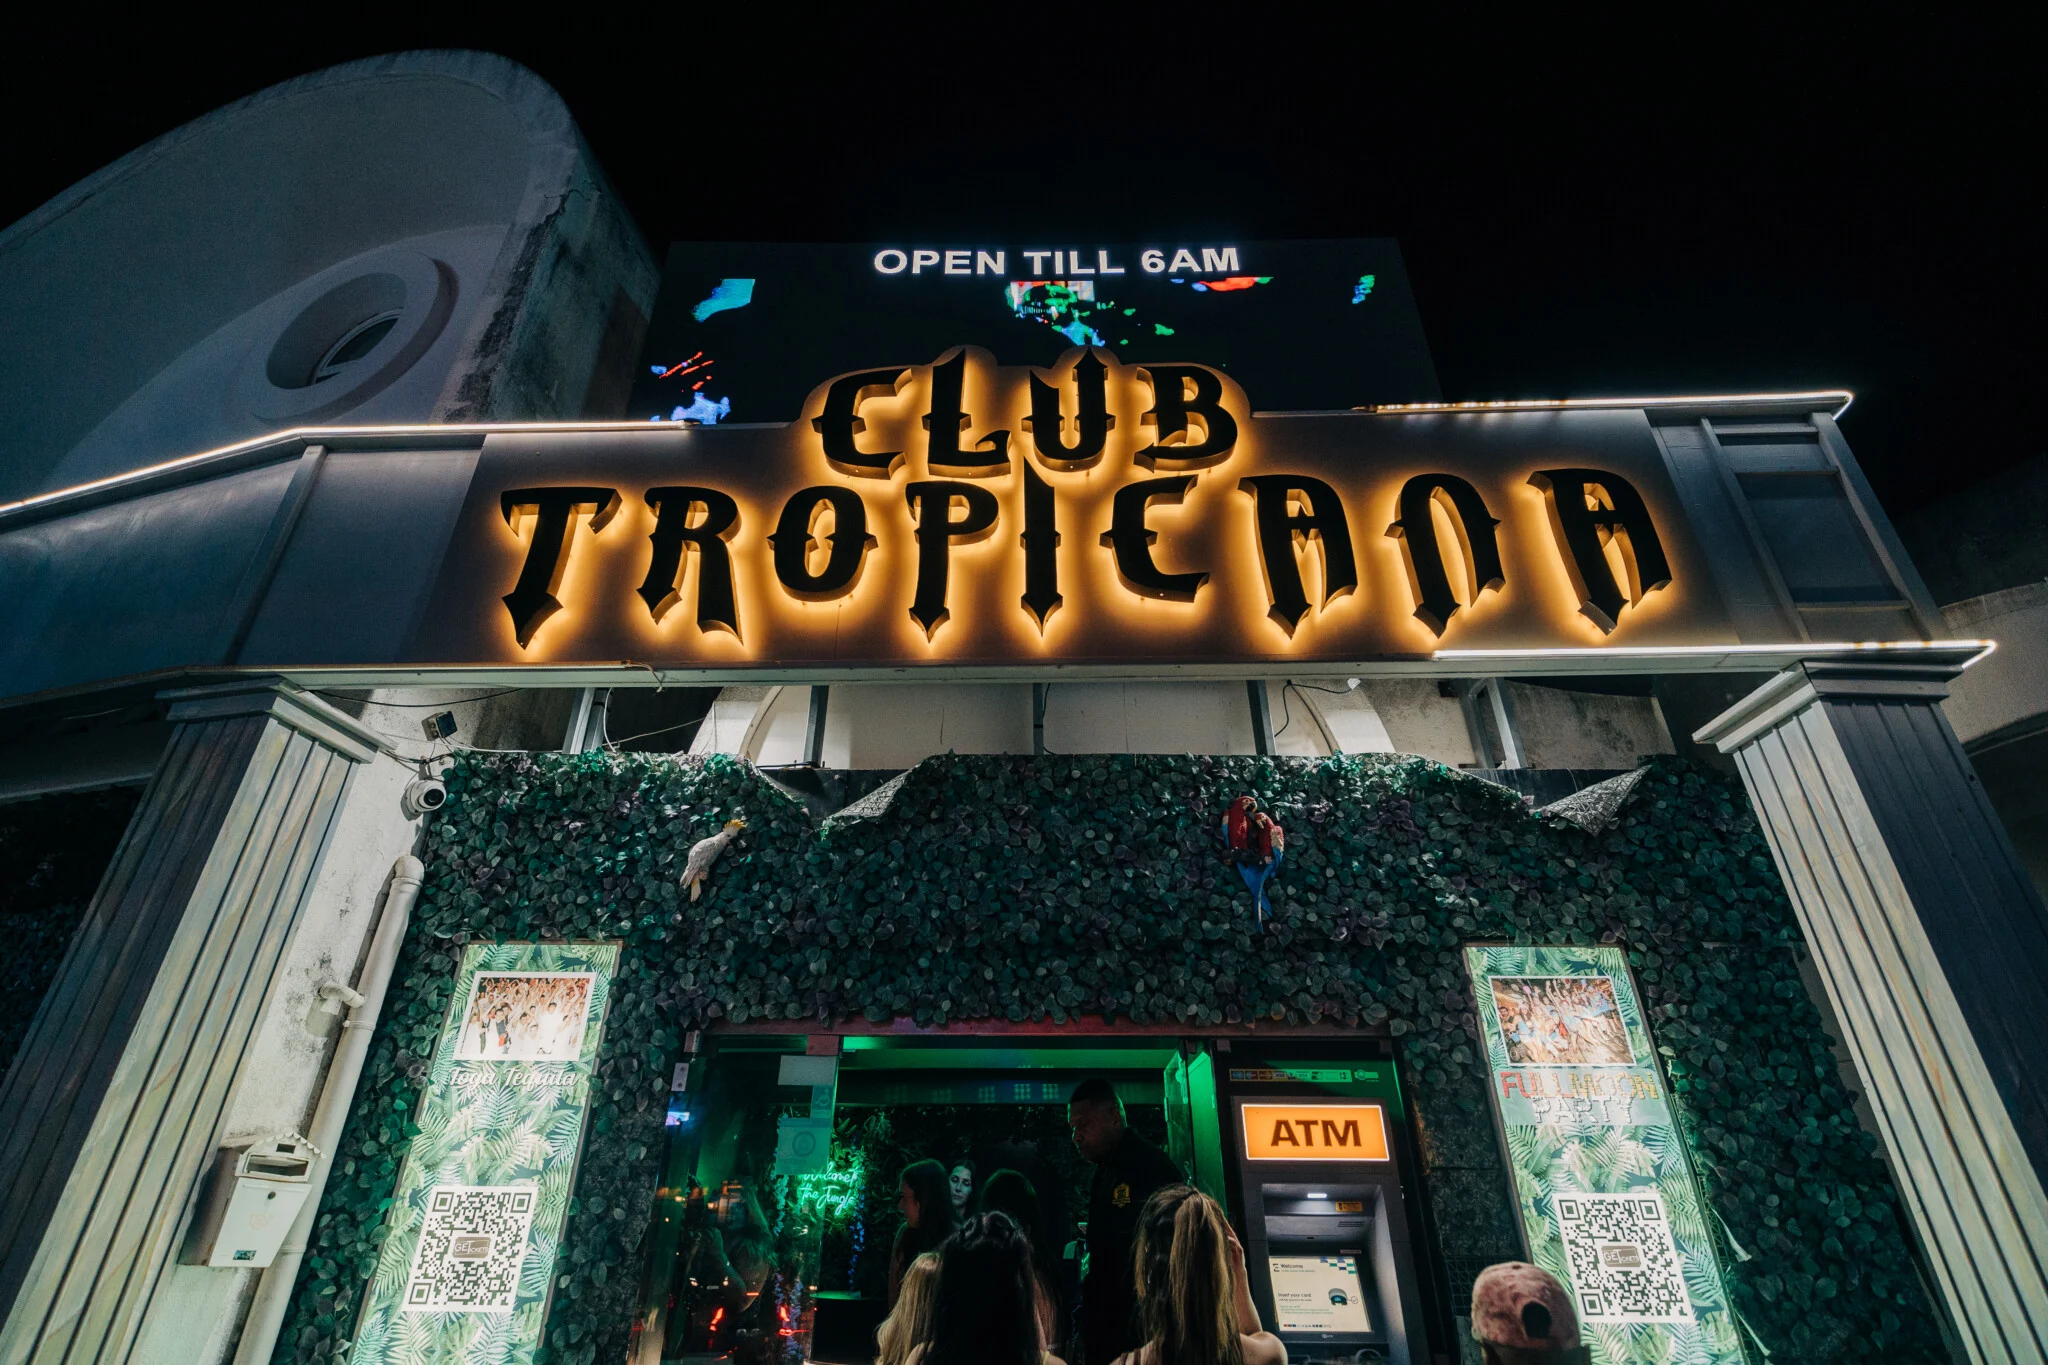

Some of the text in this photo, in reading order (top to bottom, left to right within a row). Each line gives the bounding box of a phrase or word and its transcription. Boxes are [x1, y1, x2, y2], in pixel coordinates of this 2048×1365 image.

[874, 247, 1240, 275] OPEN TILL 6AM
[811, 346, 1238, 479] CLUB
[500, 457, 1673, 651] TROPICANA
[449, 1066, 579, 1092] Toga Tequila
[1531, 1094, 1635, 1124] PARTY
[1270, 1119, 1362, 1147] ATM
